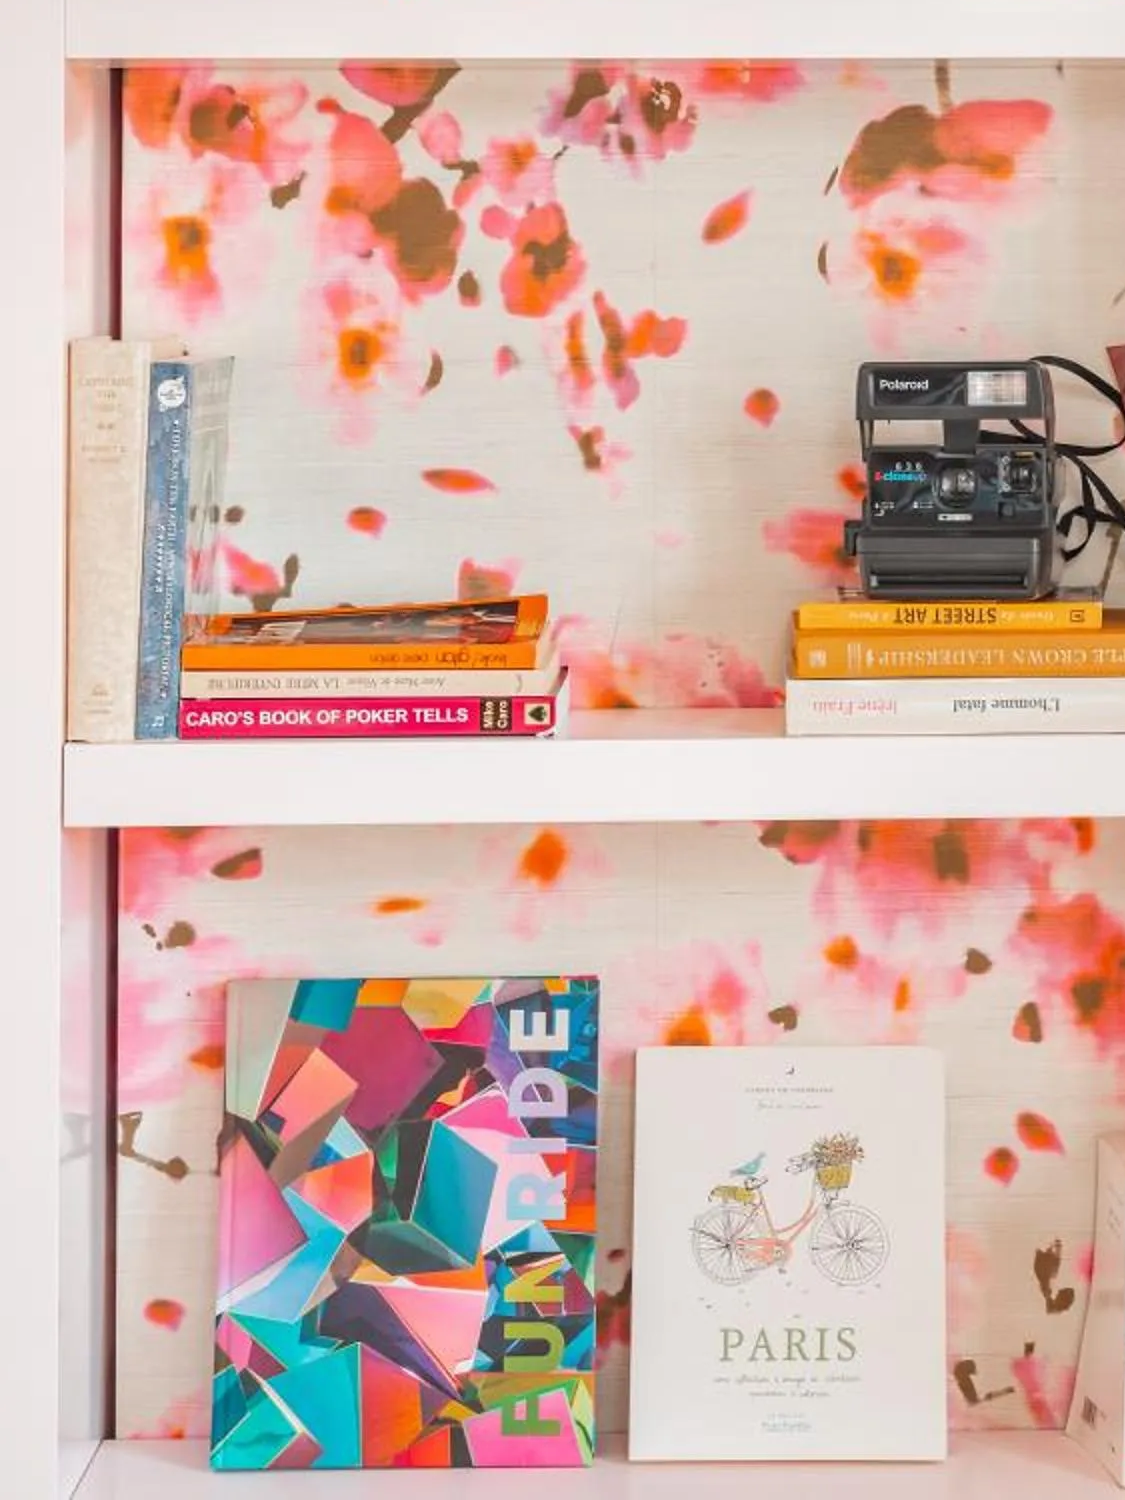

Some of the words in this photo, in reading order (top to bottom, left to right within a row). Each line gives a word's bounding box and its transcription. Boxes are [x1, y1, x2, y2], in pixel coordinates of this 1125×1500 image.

[879, 379, 929, 391] Polaroid
[892, 607, 927, 624] ART
[934, 607, 997, 624] STREET
[876, 648, 1004, 668] LEADERSHIP
[1012, 647, 1087, 665] CROWN
[323, 677, 341, 690] LA
[482, 700, 495, 729] Mike
[496, 700, 509, 729] Caro
[952, 699, 988, 714] fatal
[990, 698, 1061, 714] L'homme
[186, 709, 255, 727] CARO'S
[259, 708, 314, 726] BOOK
[317, 708, 342, 725] OF
[345, 706, 408, 725] POKER
[411, 706, 469, 724] TELLS
[506, 1008, 571, 1222] RIDE
[501, 1257, 566, 1437] FUN
[718, 1327, 858, 1363] PARIS
